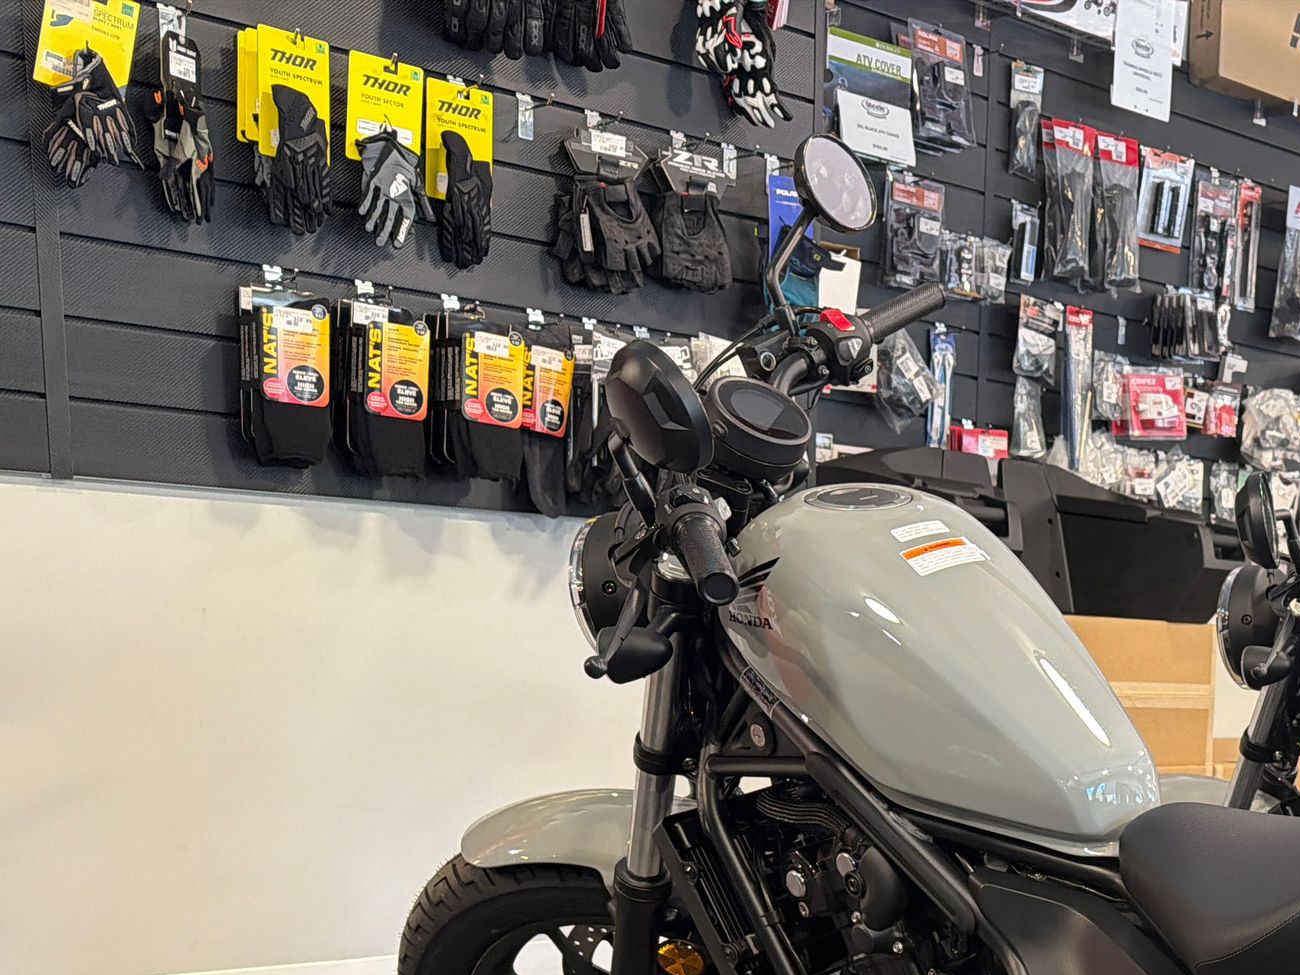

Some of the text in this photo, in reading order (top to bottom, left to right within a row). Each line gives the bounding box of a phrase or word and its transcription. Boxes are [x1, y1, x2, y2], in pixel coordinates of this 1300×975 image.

[270, 49, 317, 71] THOR
[856, 53, 902, 76] ATV COVER
[270, 67, 291, 78] YOUTH
[292, 73, 323, 85] SPECTRUM
[362, 74, 411, 97] THOR
[361, 93, 405, 108] YOUTH SECTOR
[437, 100, 482, 120] THOR
[460, 121, 487, 133] SPECTRUM
[368, 329, 382, 389] NAT'S
[729, 610, 774, 630] HONDA
